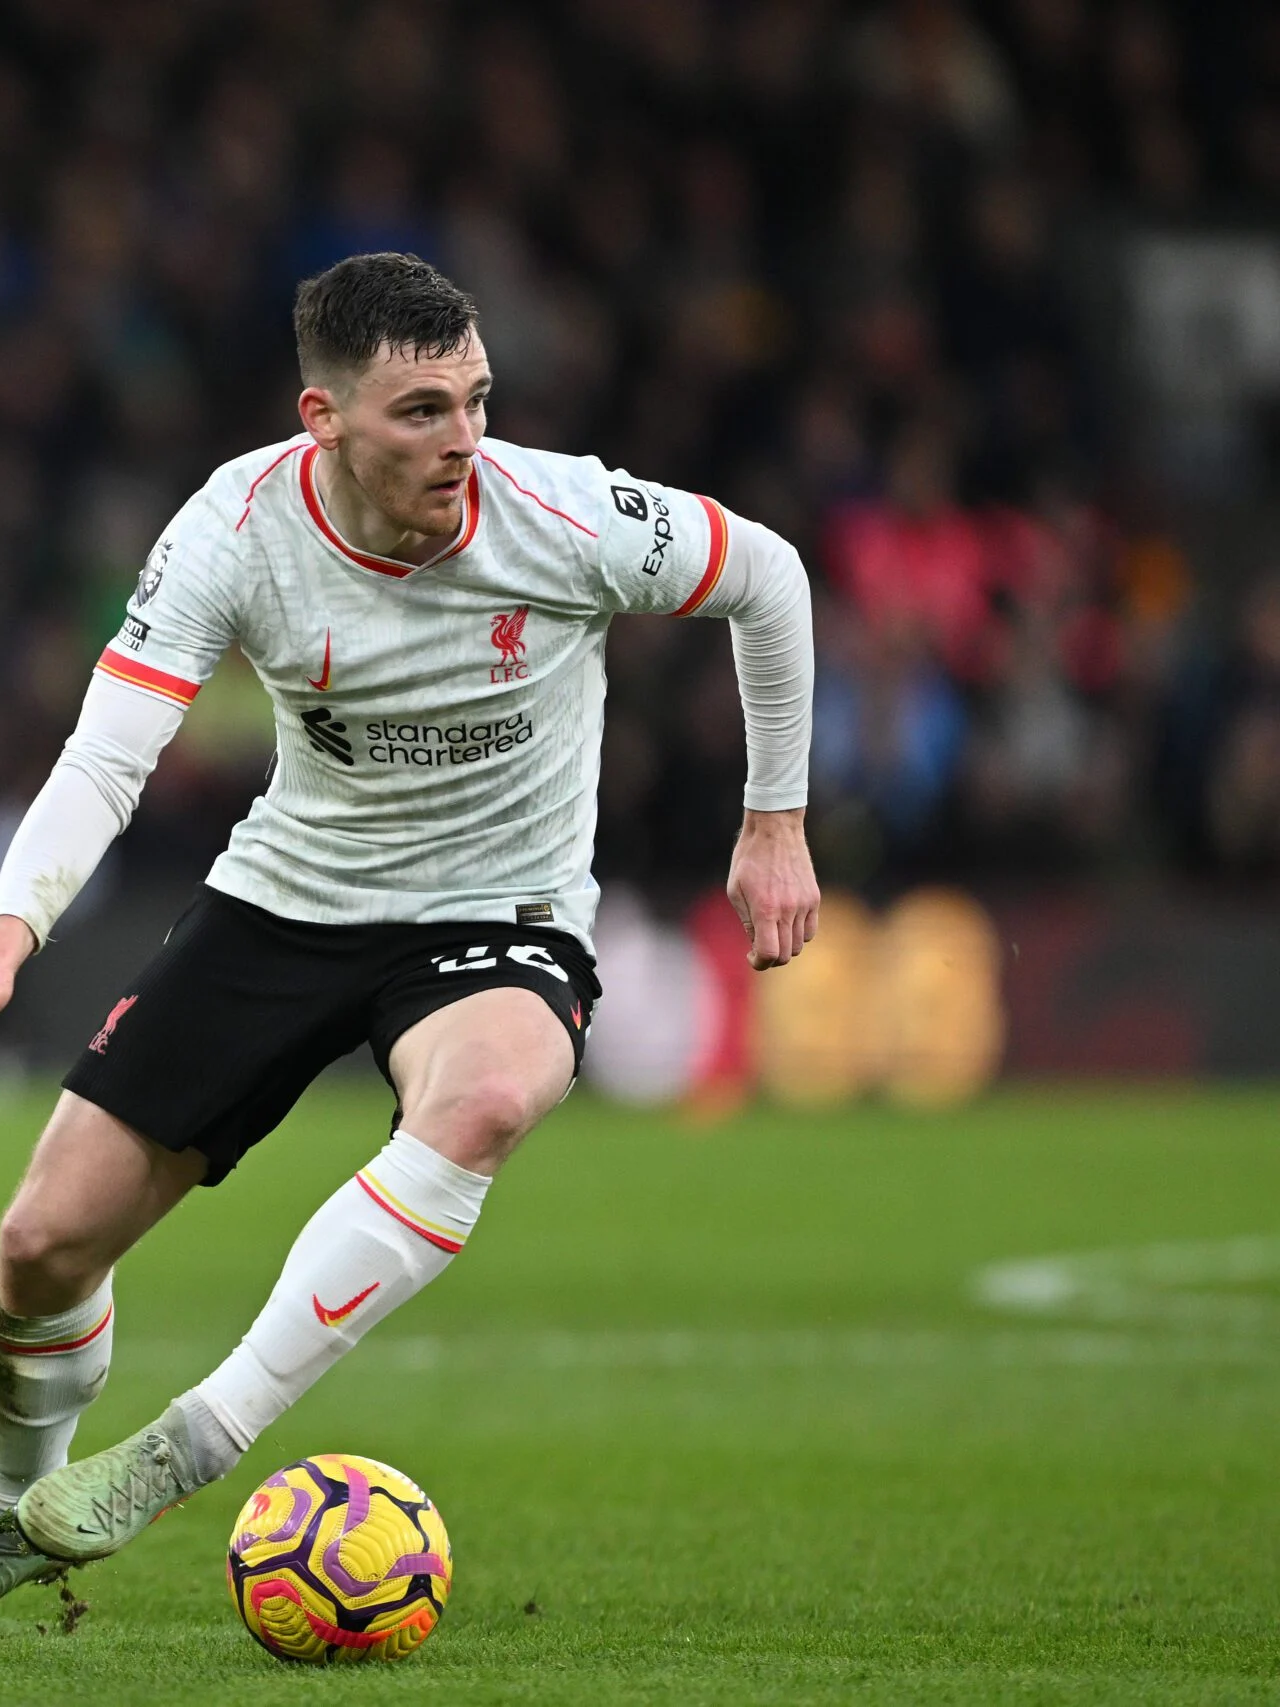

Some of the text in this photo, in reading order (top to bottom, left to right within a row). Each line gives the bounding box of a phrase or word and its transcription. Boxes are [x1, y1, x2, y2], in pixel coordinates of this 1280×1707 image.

[641, 483, 674, 577] Expe
[366, 711, 524, 744] standard
[369, 720, 533, 767] chartered
